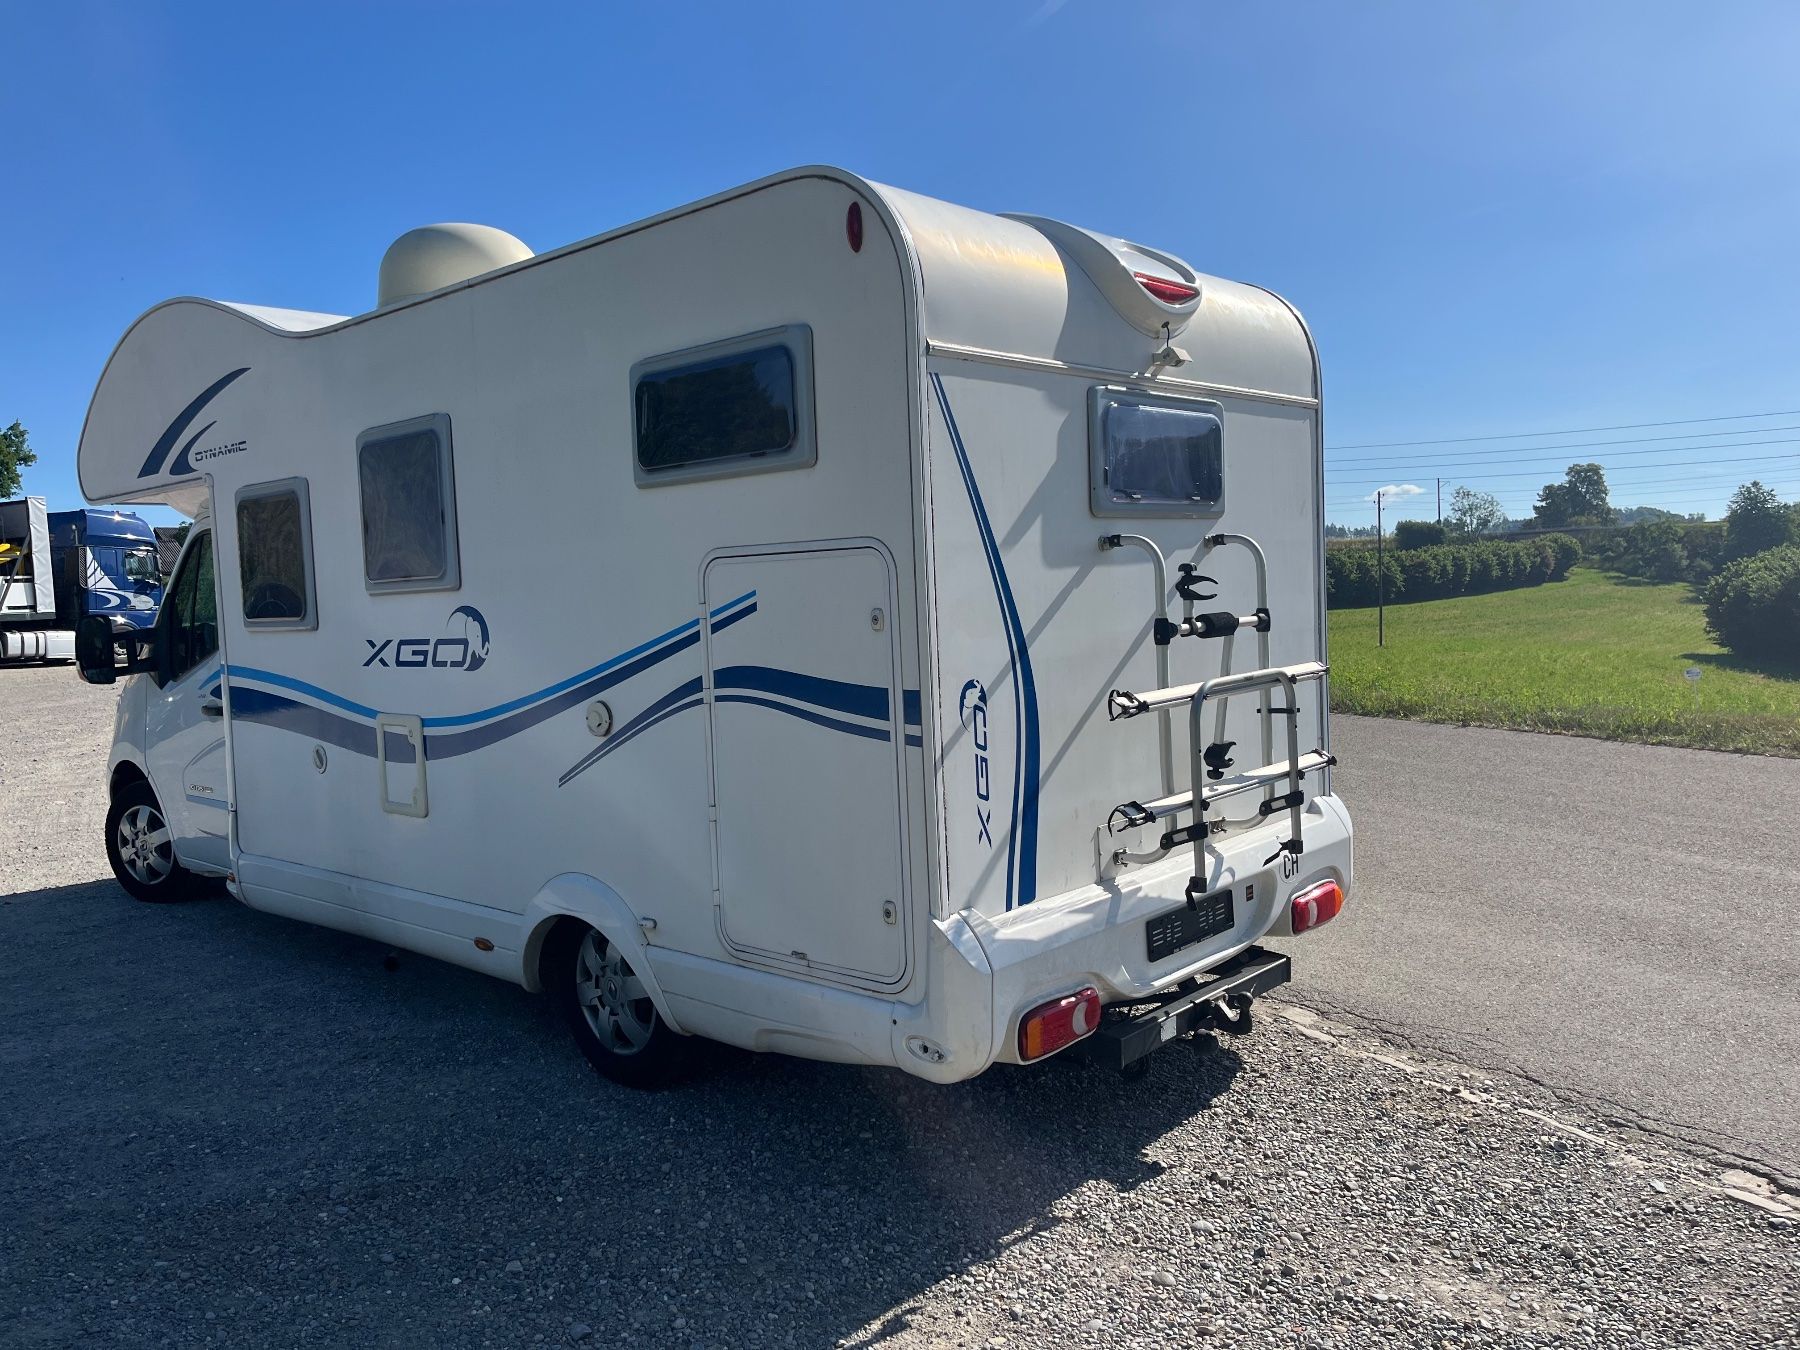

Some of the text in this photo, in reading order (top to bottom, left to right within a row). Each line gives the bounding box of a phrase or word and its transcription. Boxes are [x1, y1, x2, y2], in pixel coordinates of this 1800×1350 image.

[194, 440, 248, 462] DYNAMIC
[362, 638, 469, 668] XGO
[973, 704, 992, 849] XGO
[1283, 853, 1299, 880] CH
